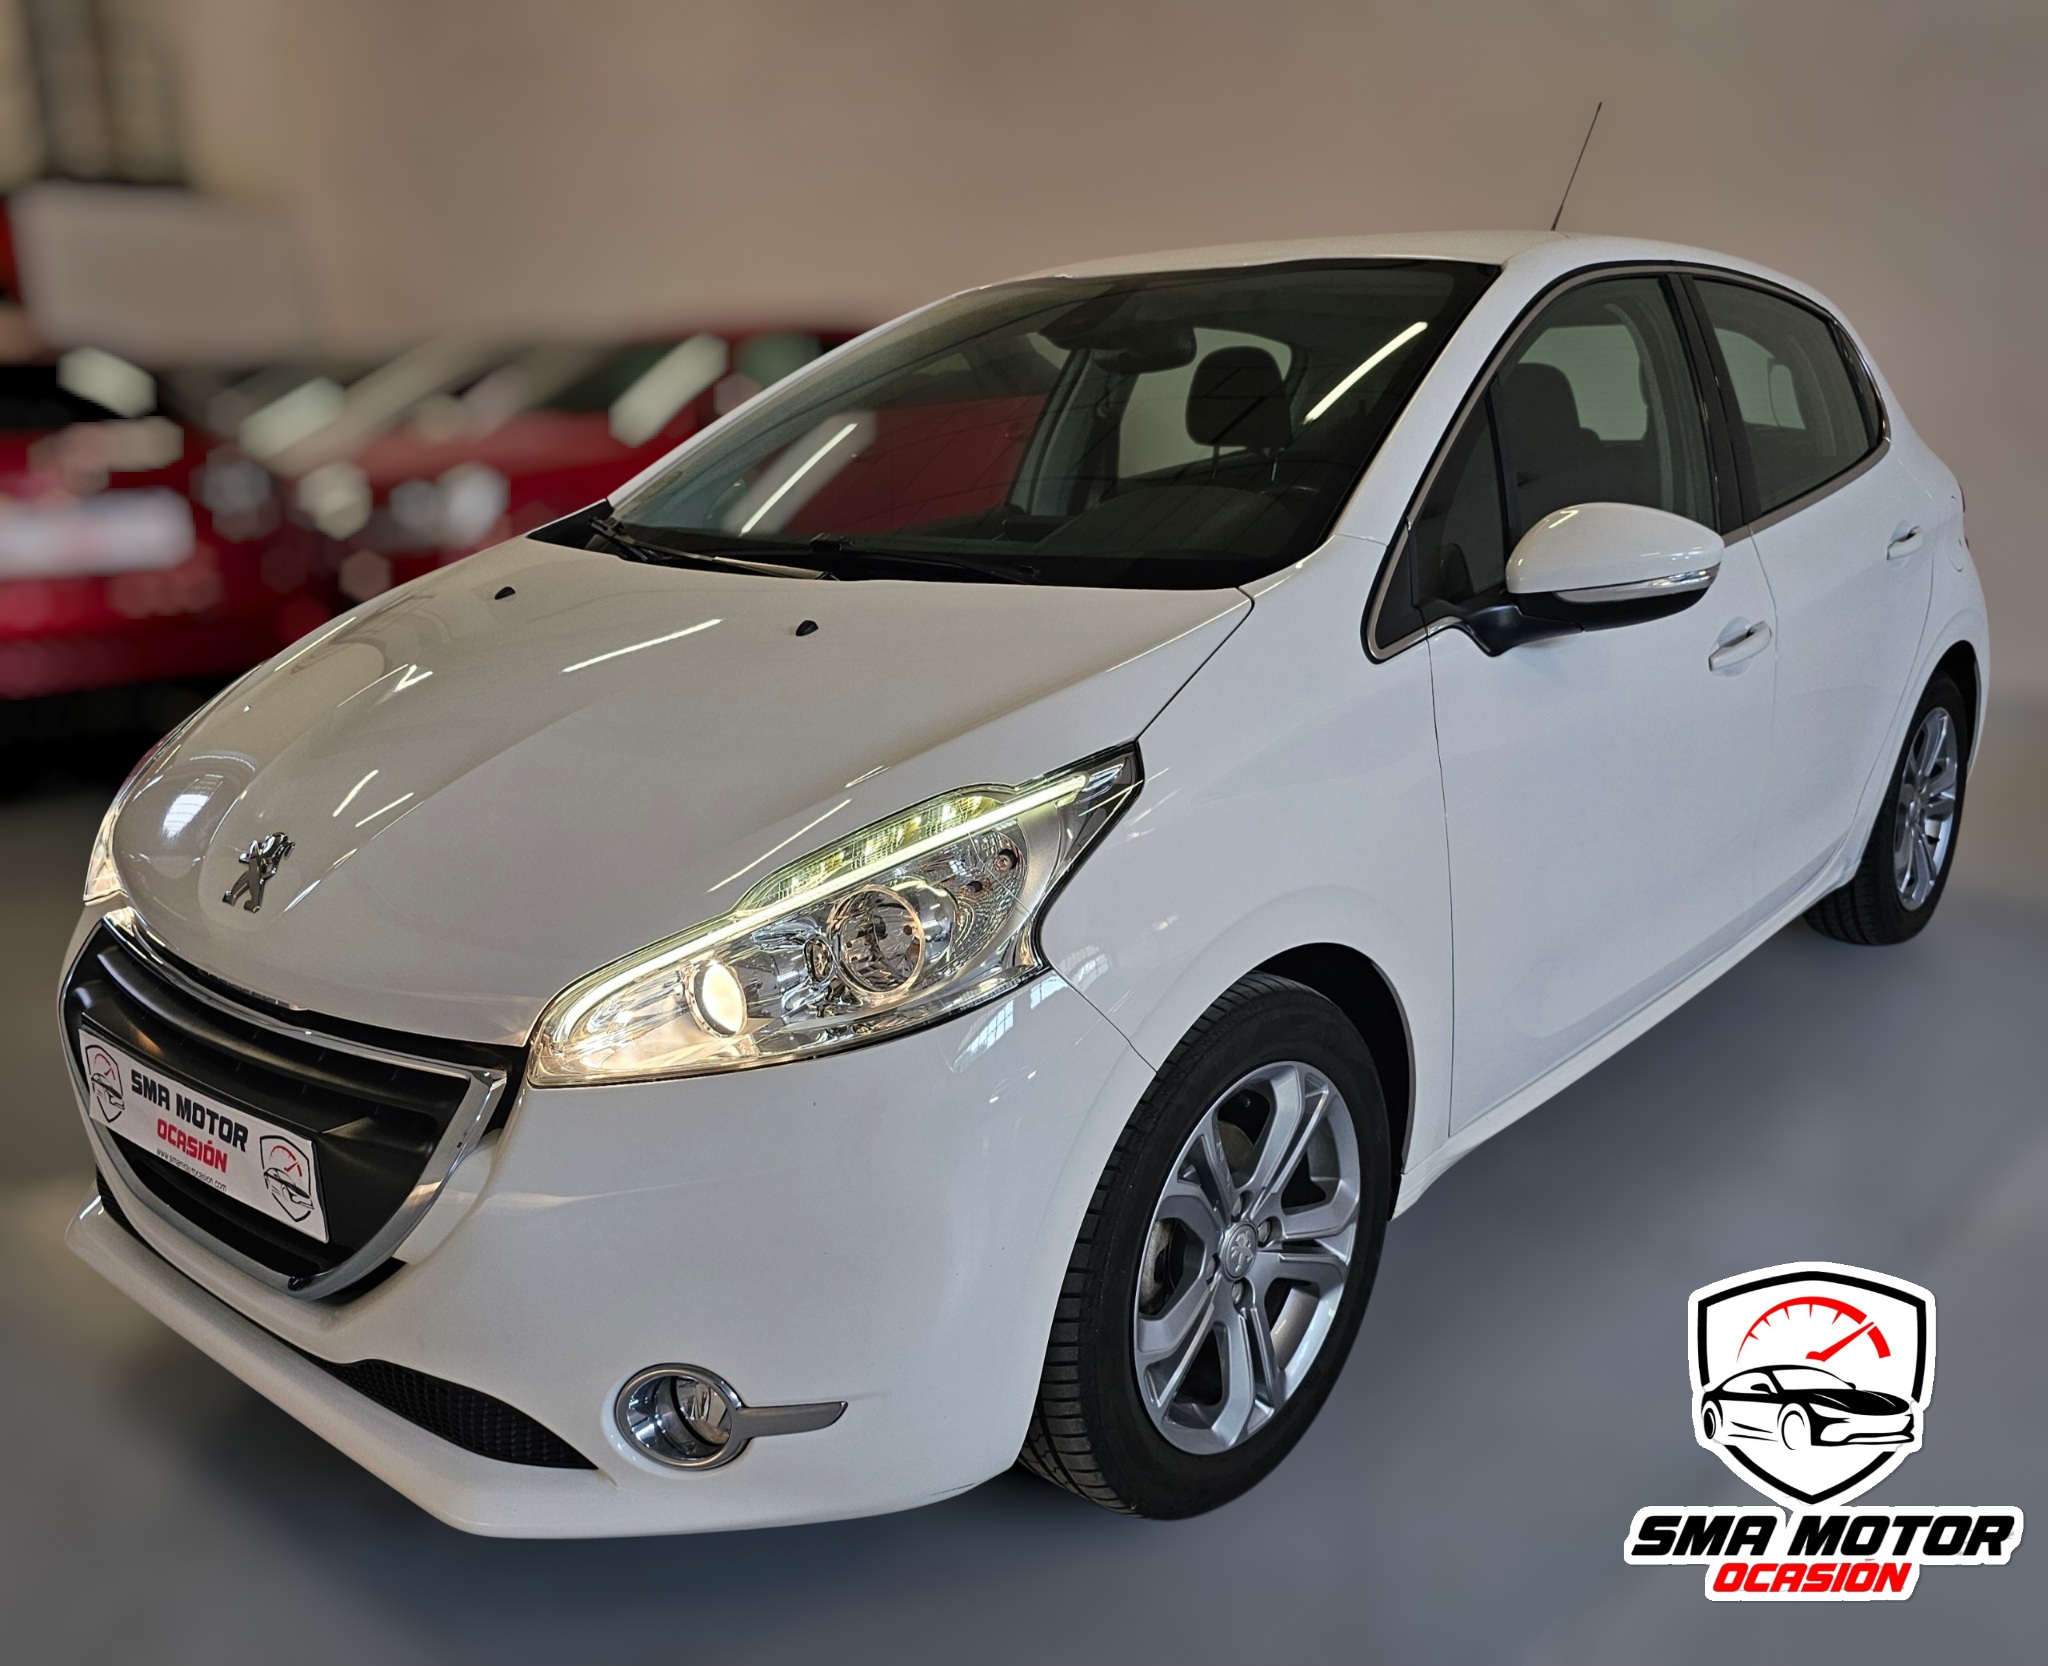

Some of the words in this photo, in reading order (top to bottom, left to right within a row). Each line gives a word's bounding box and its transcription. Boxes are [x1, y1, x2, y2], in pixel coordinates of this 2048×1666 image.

[131, 1069, 170, 1111] SMA
[176, 1093, 248, 1152] MOTOR
[157, 1118, 228, 1173] OCASIÓN
